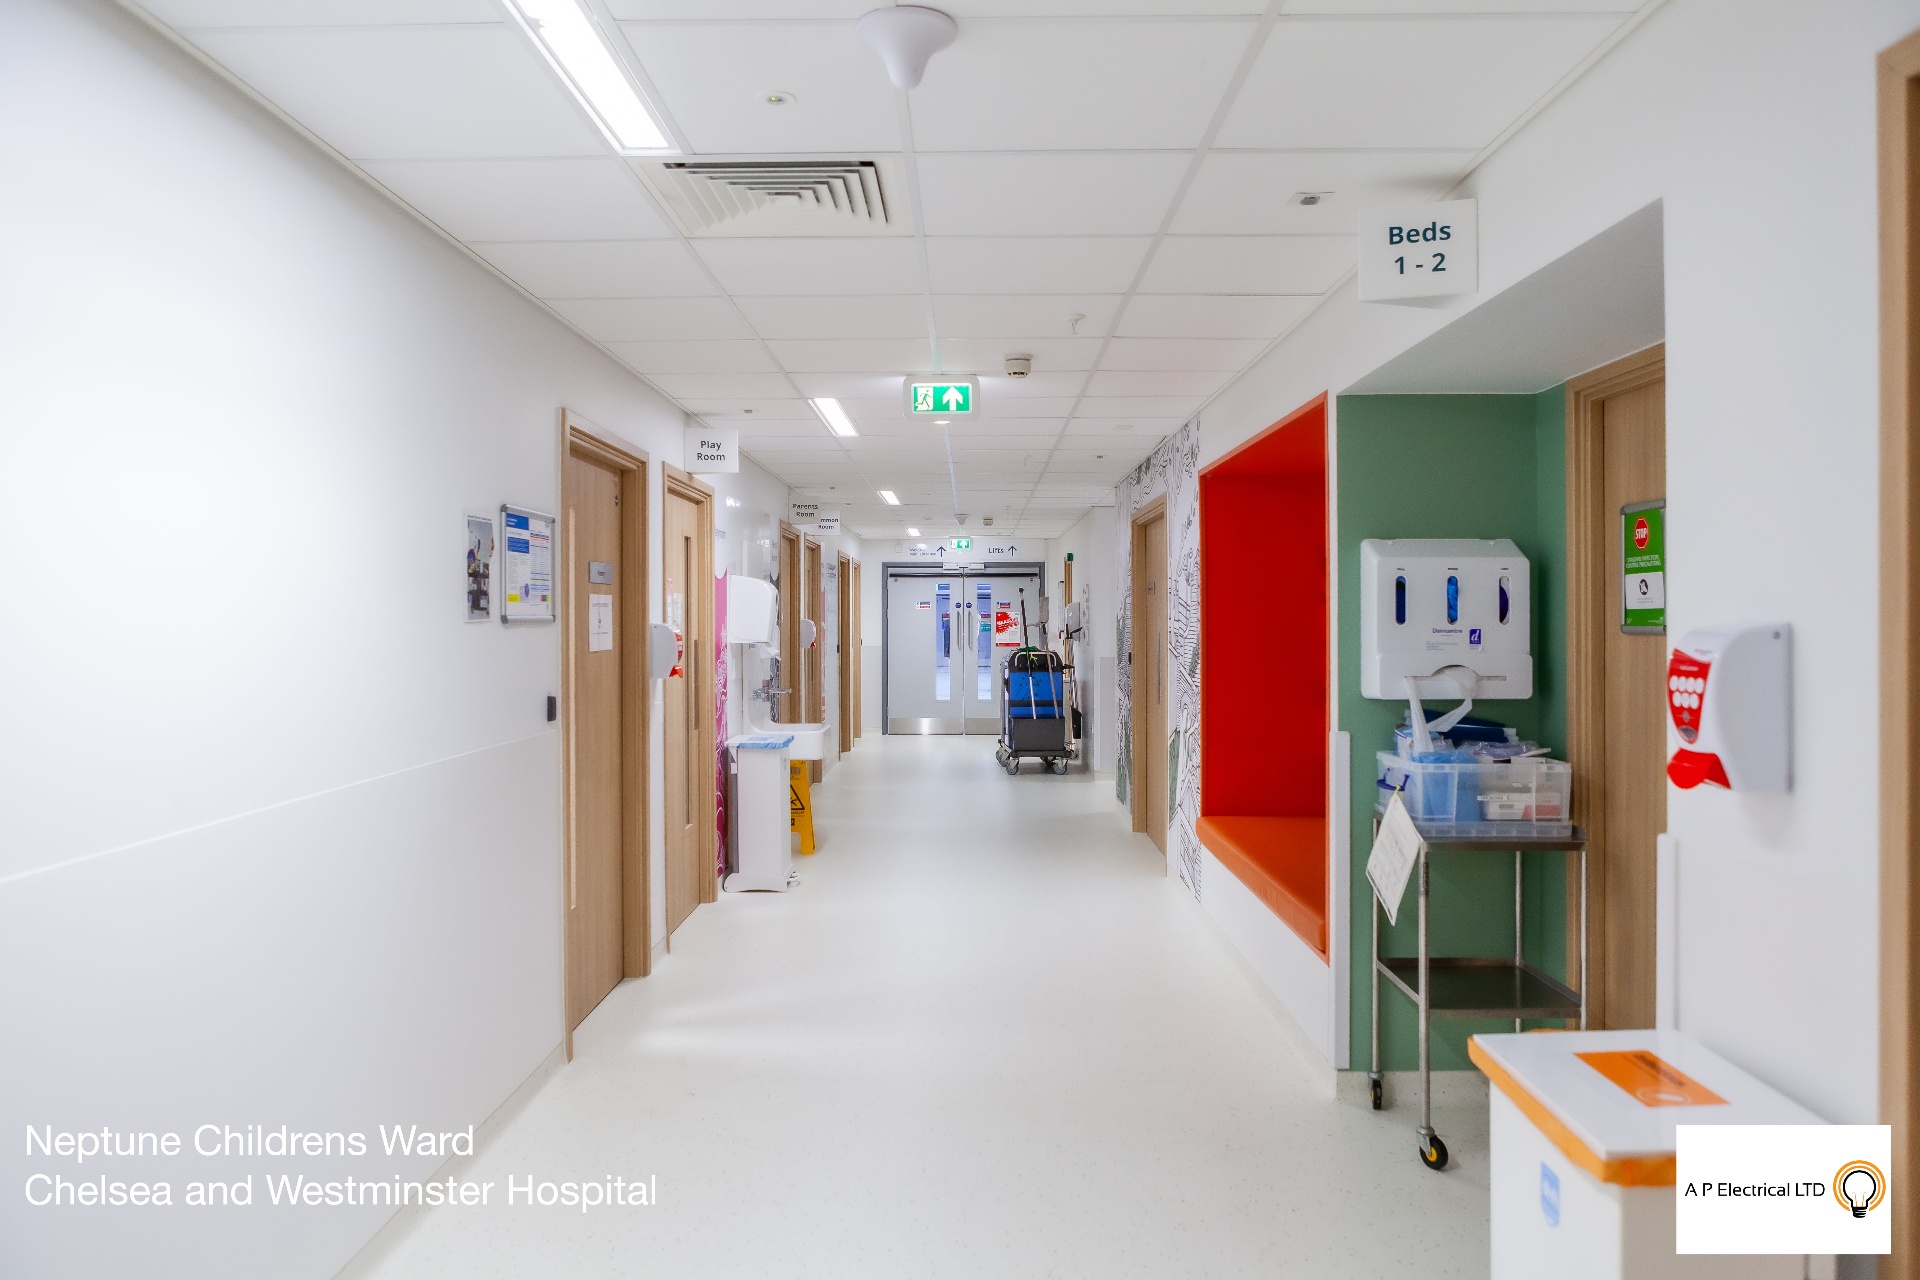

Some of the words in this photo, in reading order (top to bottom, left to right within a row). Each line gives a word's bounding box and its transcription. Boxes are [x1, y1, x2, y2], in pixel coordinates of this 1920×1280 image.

[1388, 221, 1452, 245] Beds
[1394, 256, 1405, 275] 1
[1431, 252, 1447, 272] 2
[700, 440, 722, 451] Play
[697, 452, 726, 461] Room
[1635, 528, 1648, 540] STOP
